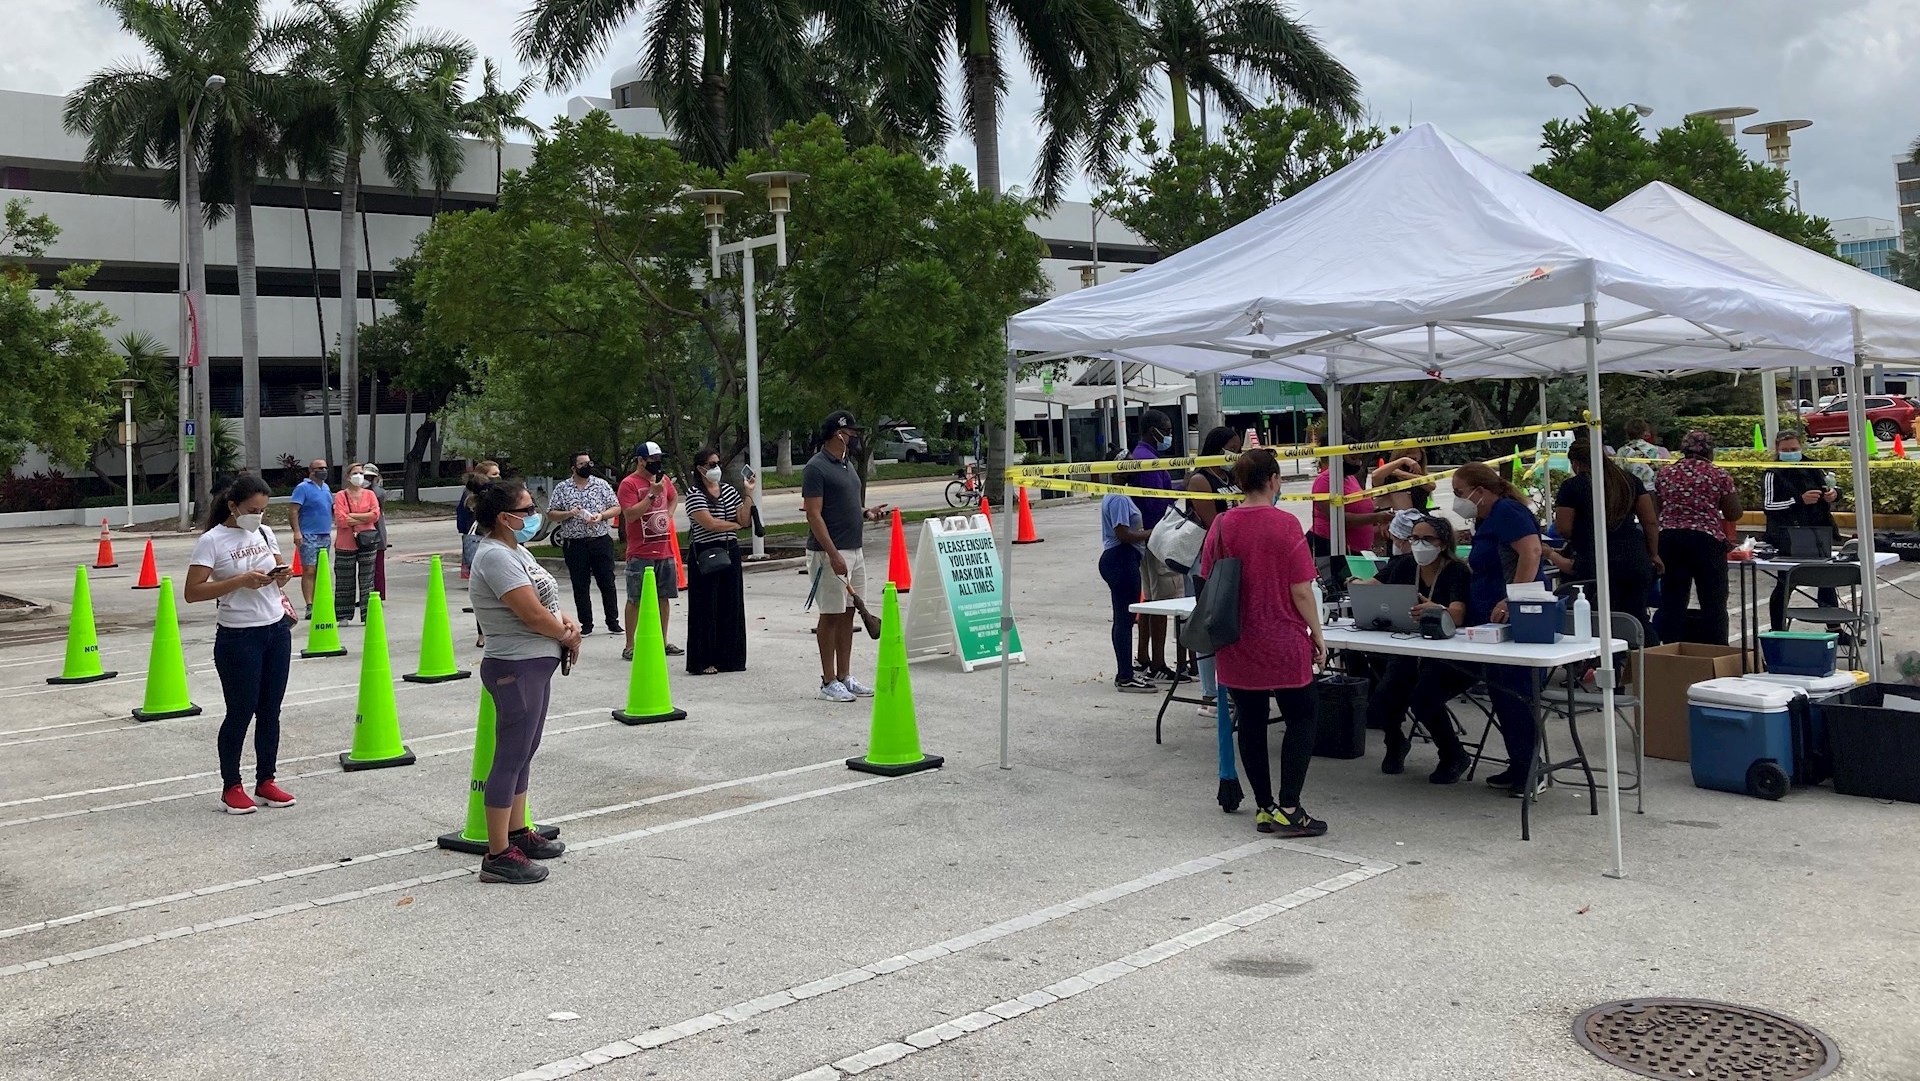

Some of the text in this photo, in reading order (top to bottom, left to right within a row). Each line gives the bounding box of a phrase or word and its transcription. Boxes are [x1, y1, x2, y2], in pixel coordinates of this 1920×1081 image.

[1022, 466, 1044, 477] CAUTION
[1067, 464, 1092, 474] CAUTION
[1116, 460, 1142, 471] CAUTION
[1169, 457, 1196, 467] CAUTION
[1284, 447, 1314, 457] CAUTION
[1347, 441, 1380, 451] CAUTION
[1416, 434, 1450, 443] CAUTION
[1489, 427, 1525, 435] CAUTION
[938, 537, 994, 554] PLEASE ENSURE
[949, 552, 990, 568] YOU HAVE A
[951, 566, 994, 582] MASK ON AT
[959, 580, 995, 596] ALL TIMES
